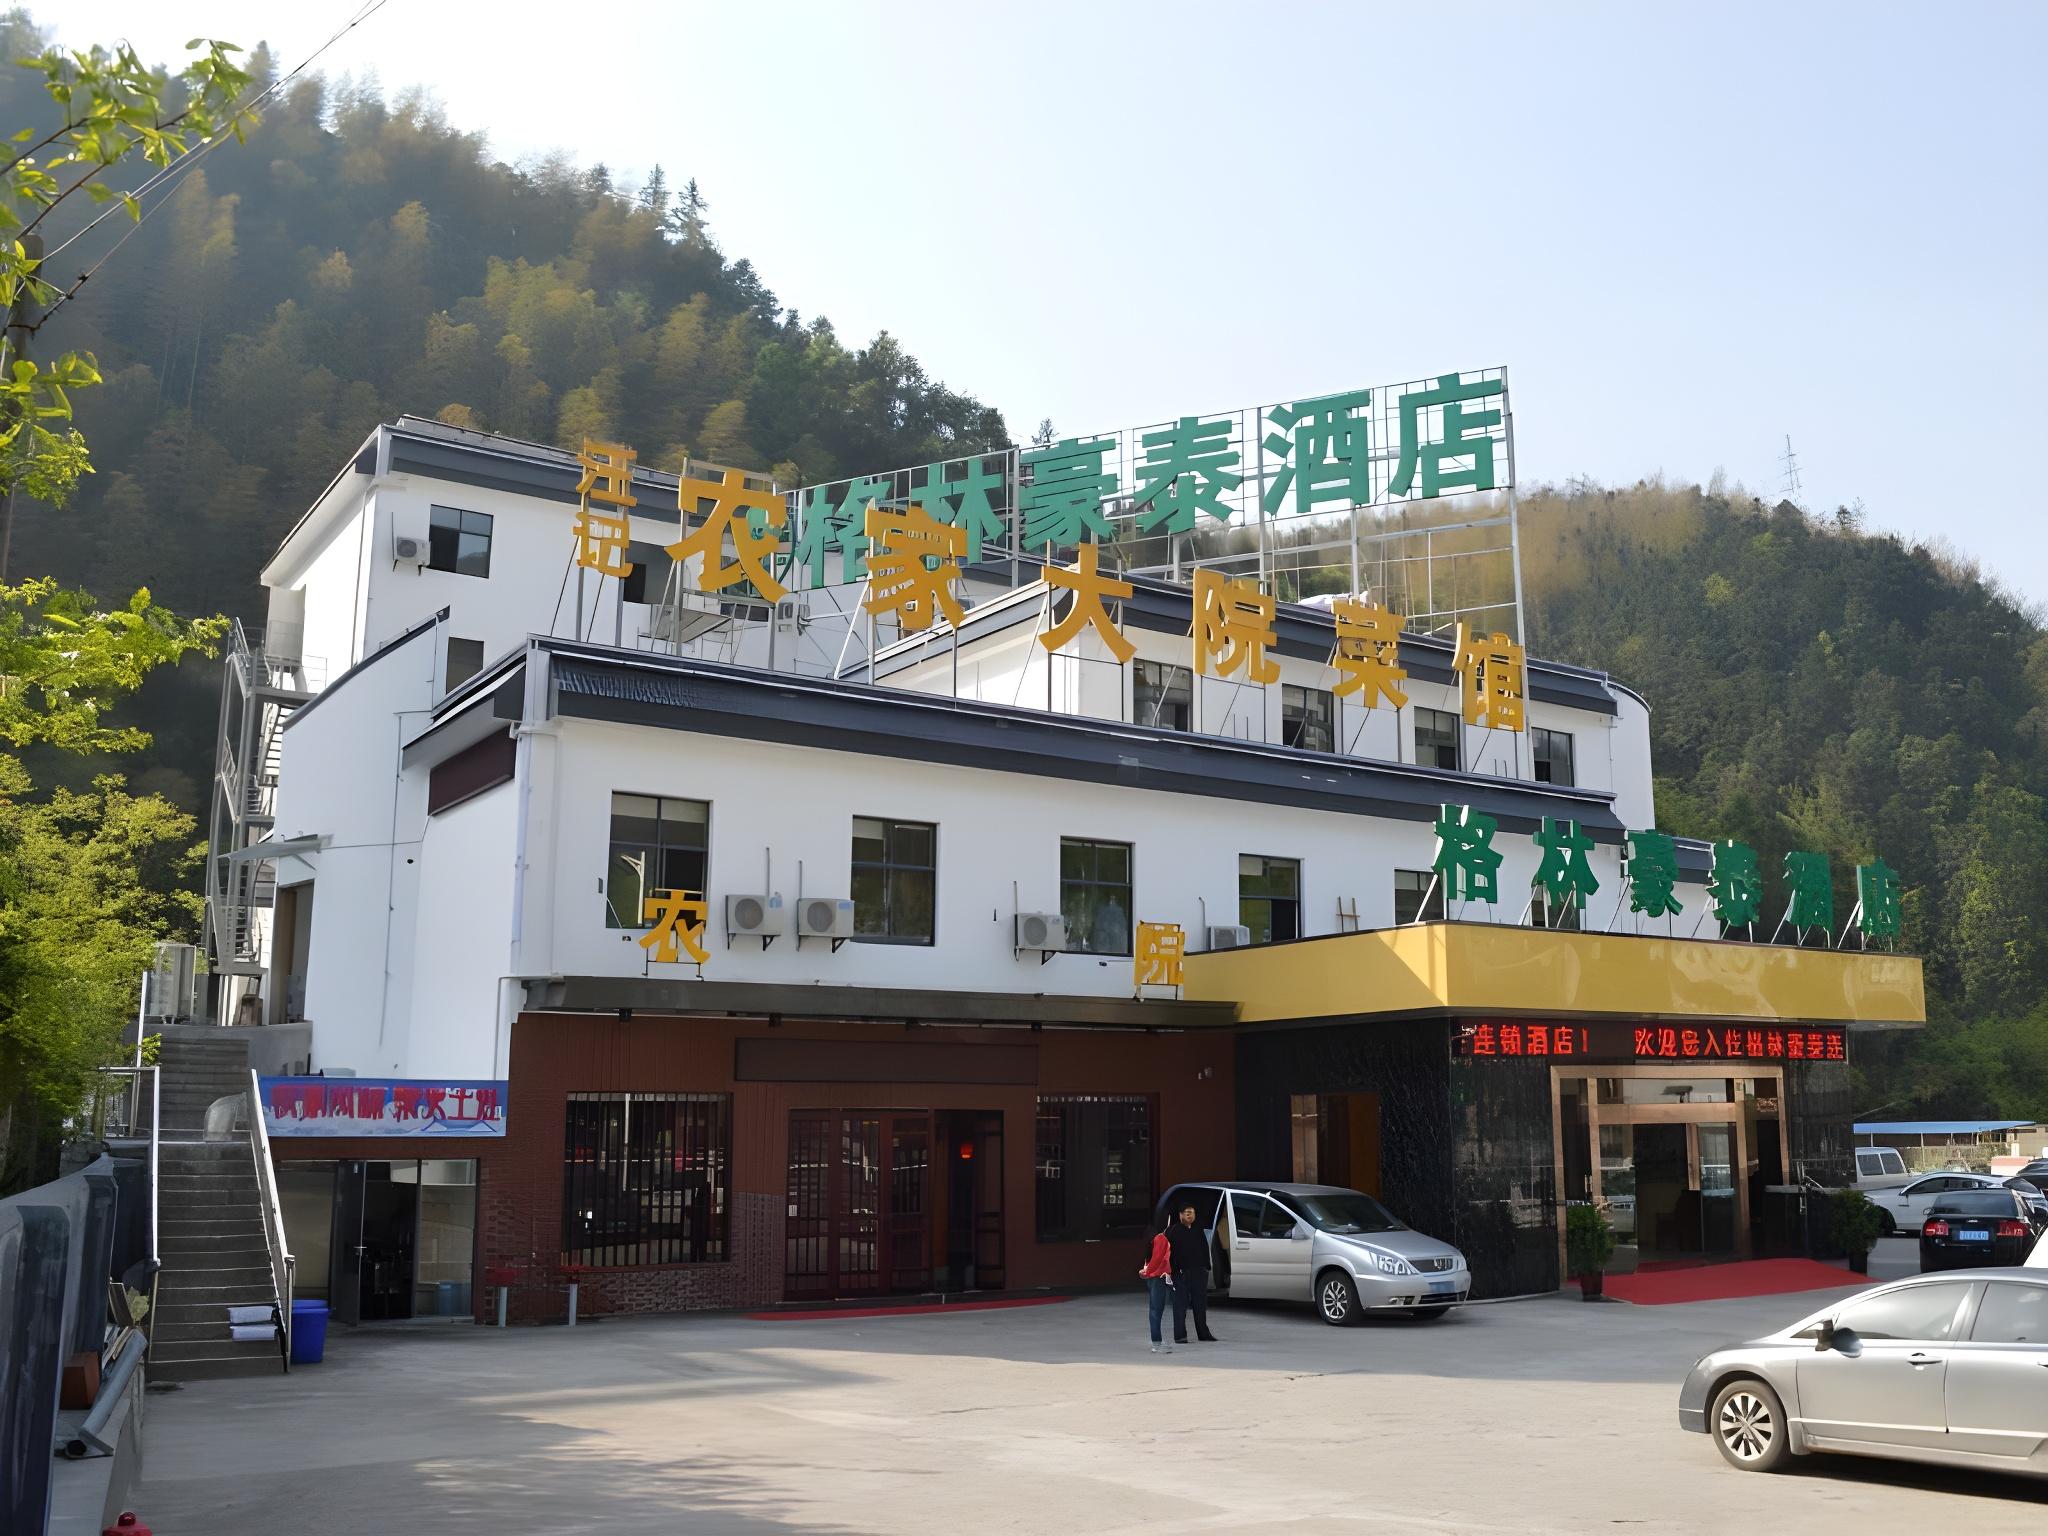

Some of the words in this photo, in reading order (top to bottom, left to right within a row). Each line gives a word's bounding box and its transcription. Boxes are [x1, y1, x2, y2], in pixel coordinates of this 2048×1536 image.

[798, 372, 1503, 589] 格林豪泰酒店
[664, 469, 1525, 732] 农家大院菜馆
[639, 889, 710, 963] 农
